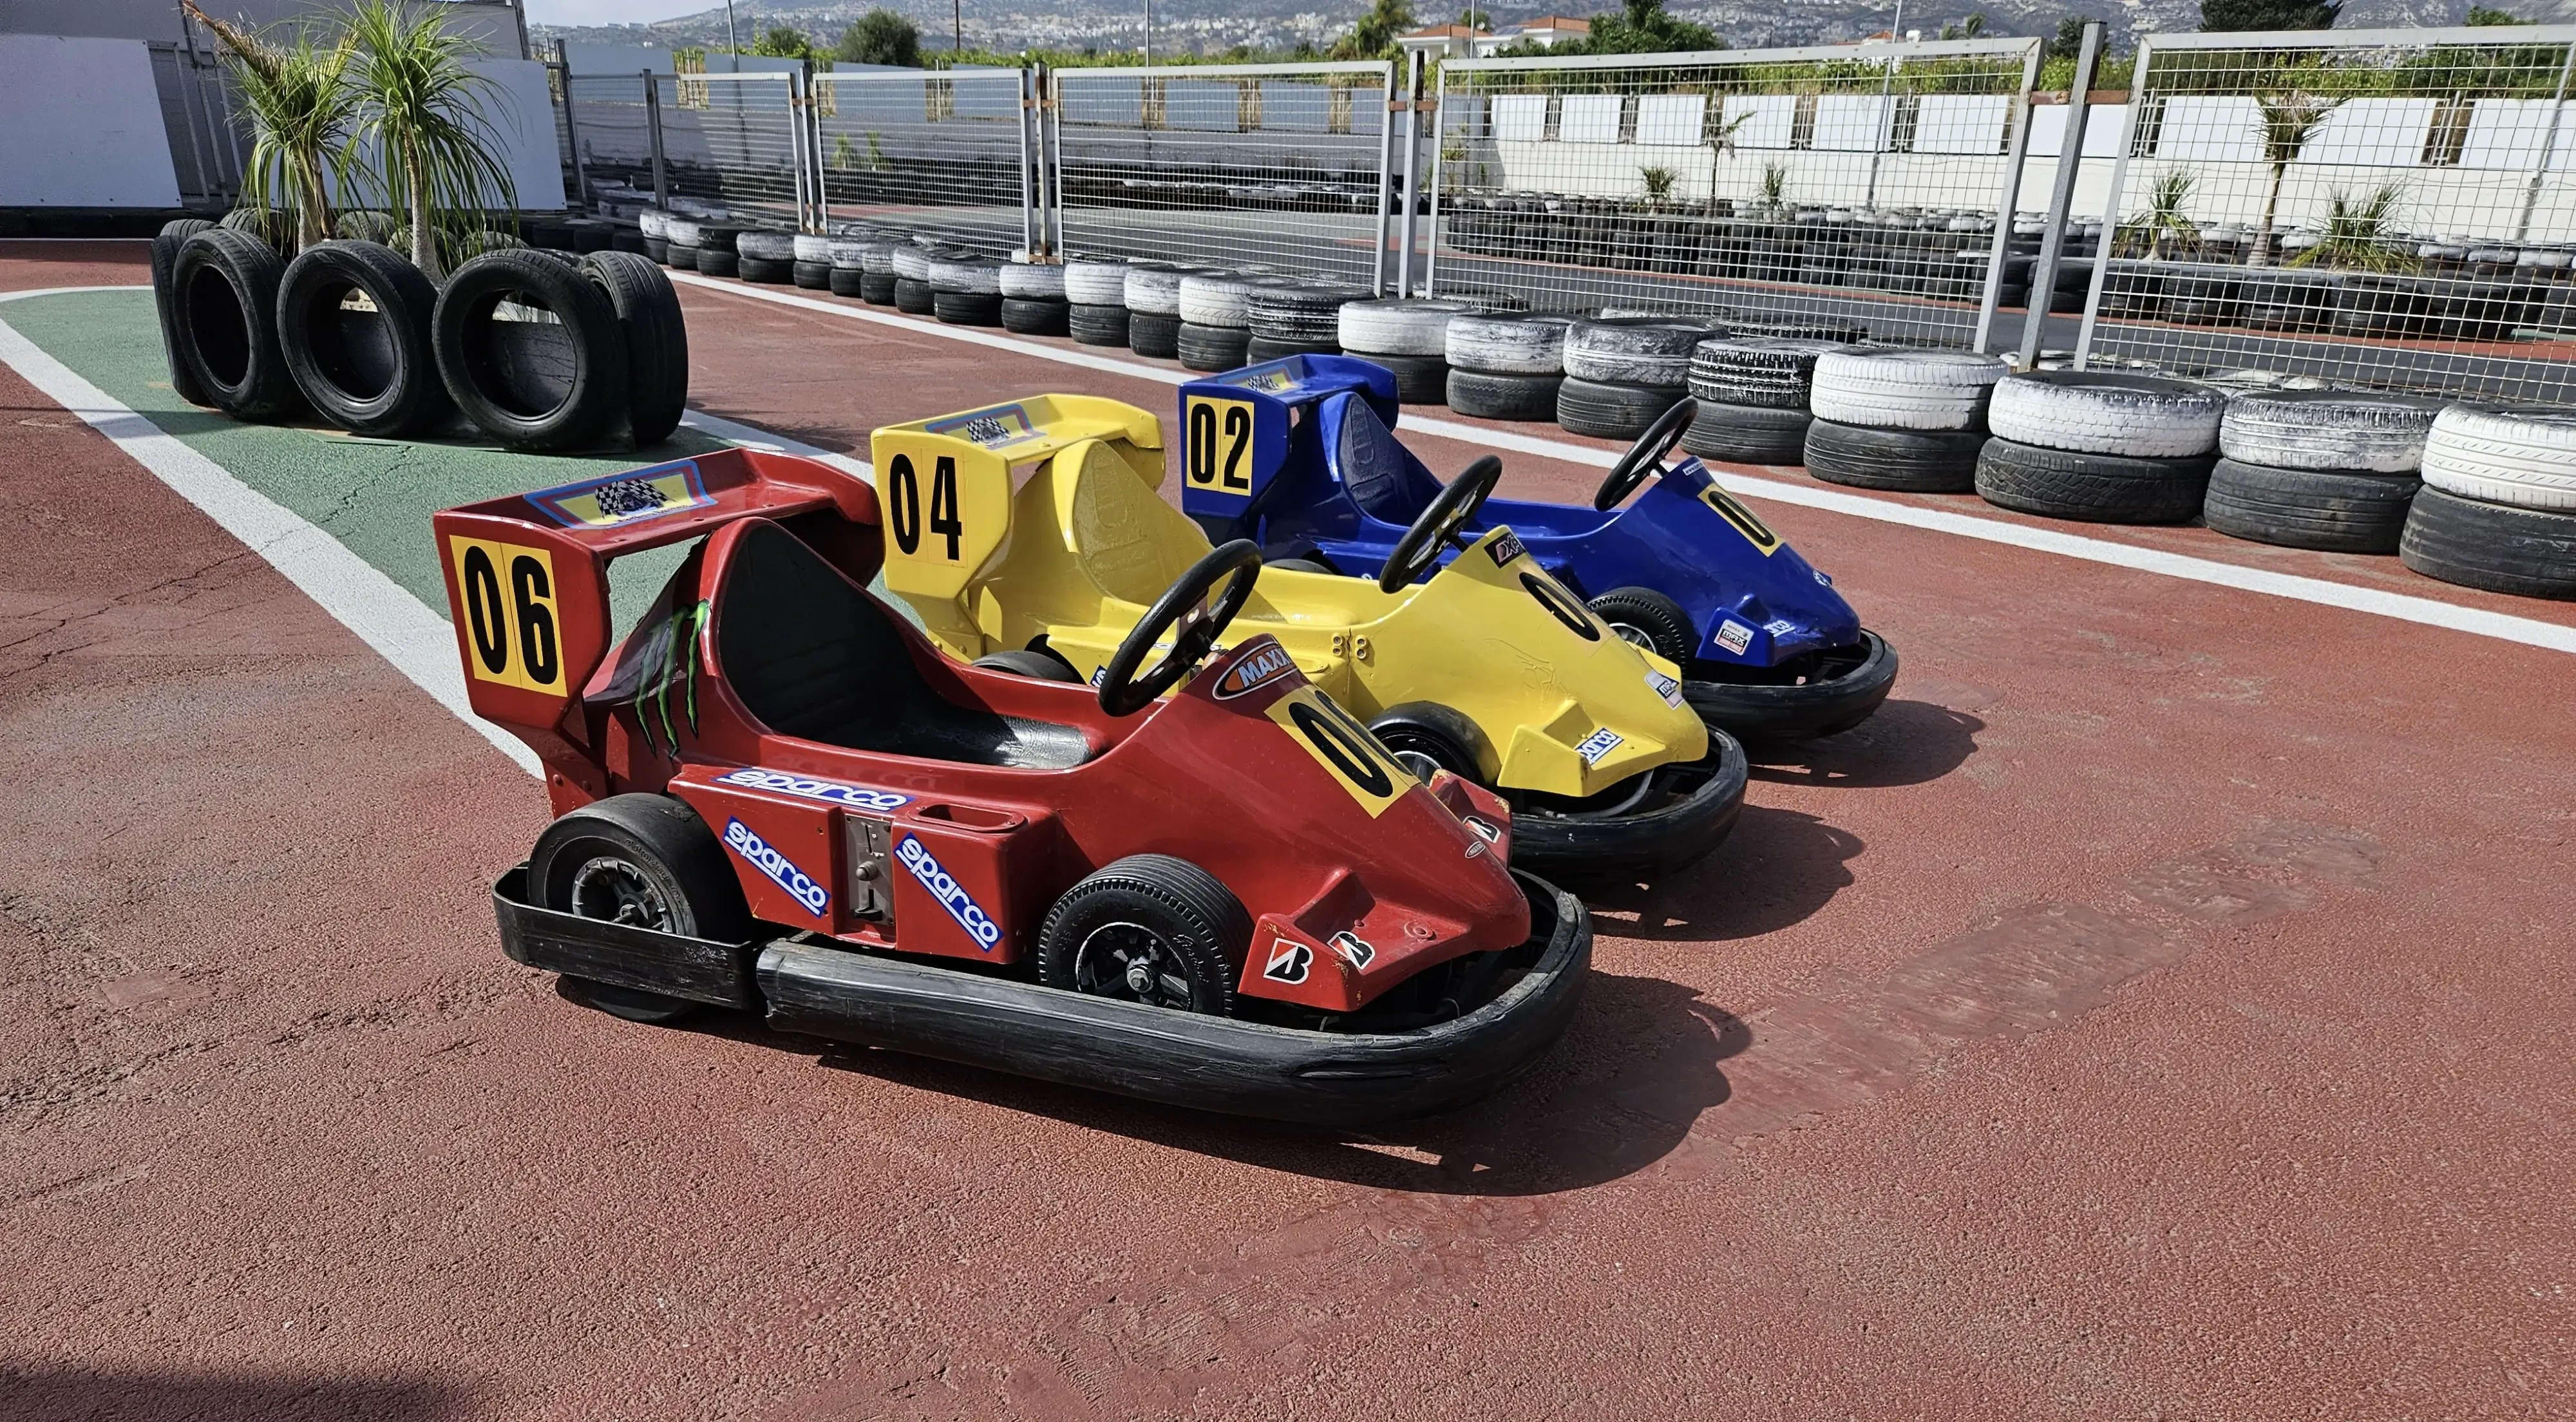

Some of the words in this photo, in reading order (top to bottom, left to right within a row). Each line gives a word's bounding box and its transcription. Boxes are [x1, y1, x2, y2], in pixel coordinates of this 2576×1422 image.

[1191, 403, 1250, 489] 02
[890, 453, 962, 560] 04
[464, 545, 558, 685] 06
[726, 771, 907, 808] sparco
[727, 821, 827, 909] sparco
[900, 838, 998, 944] sparco
